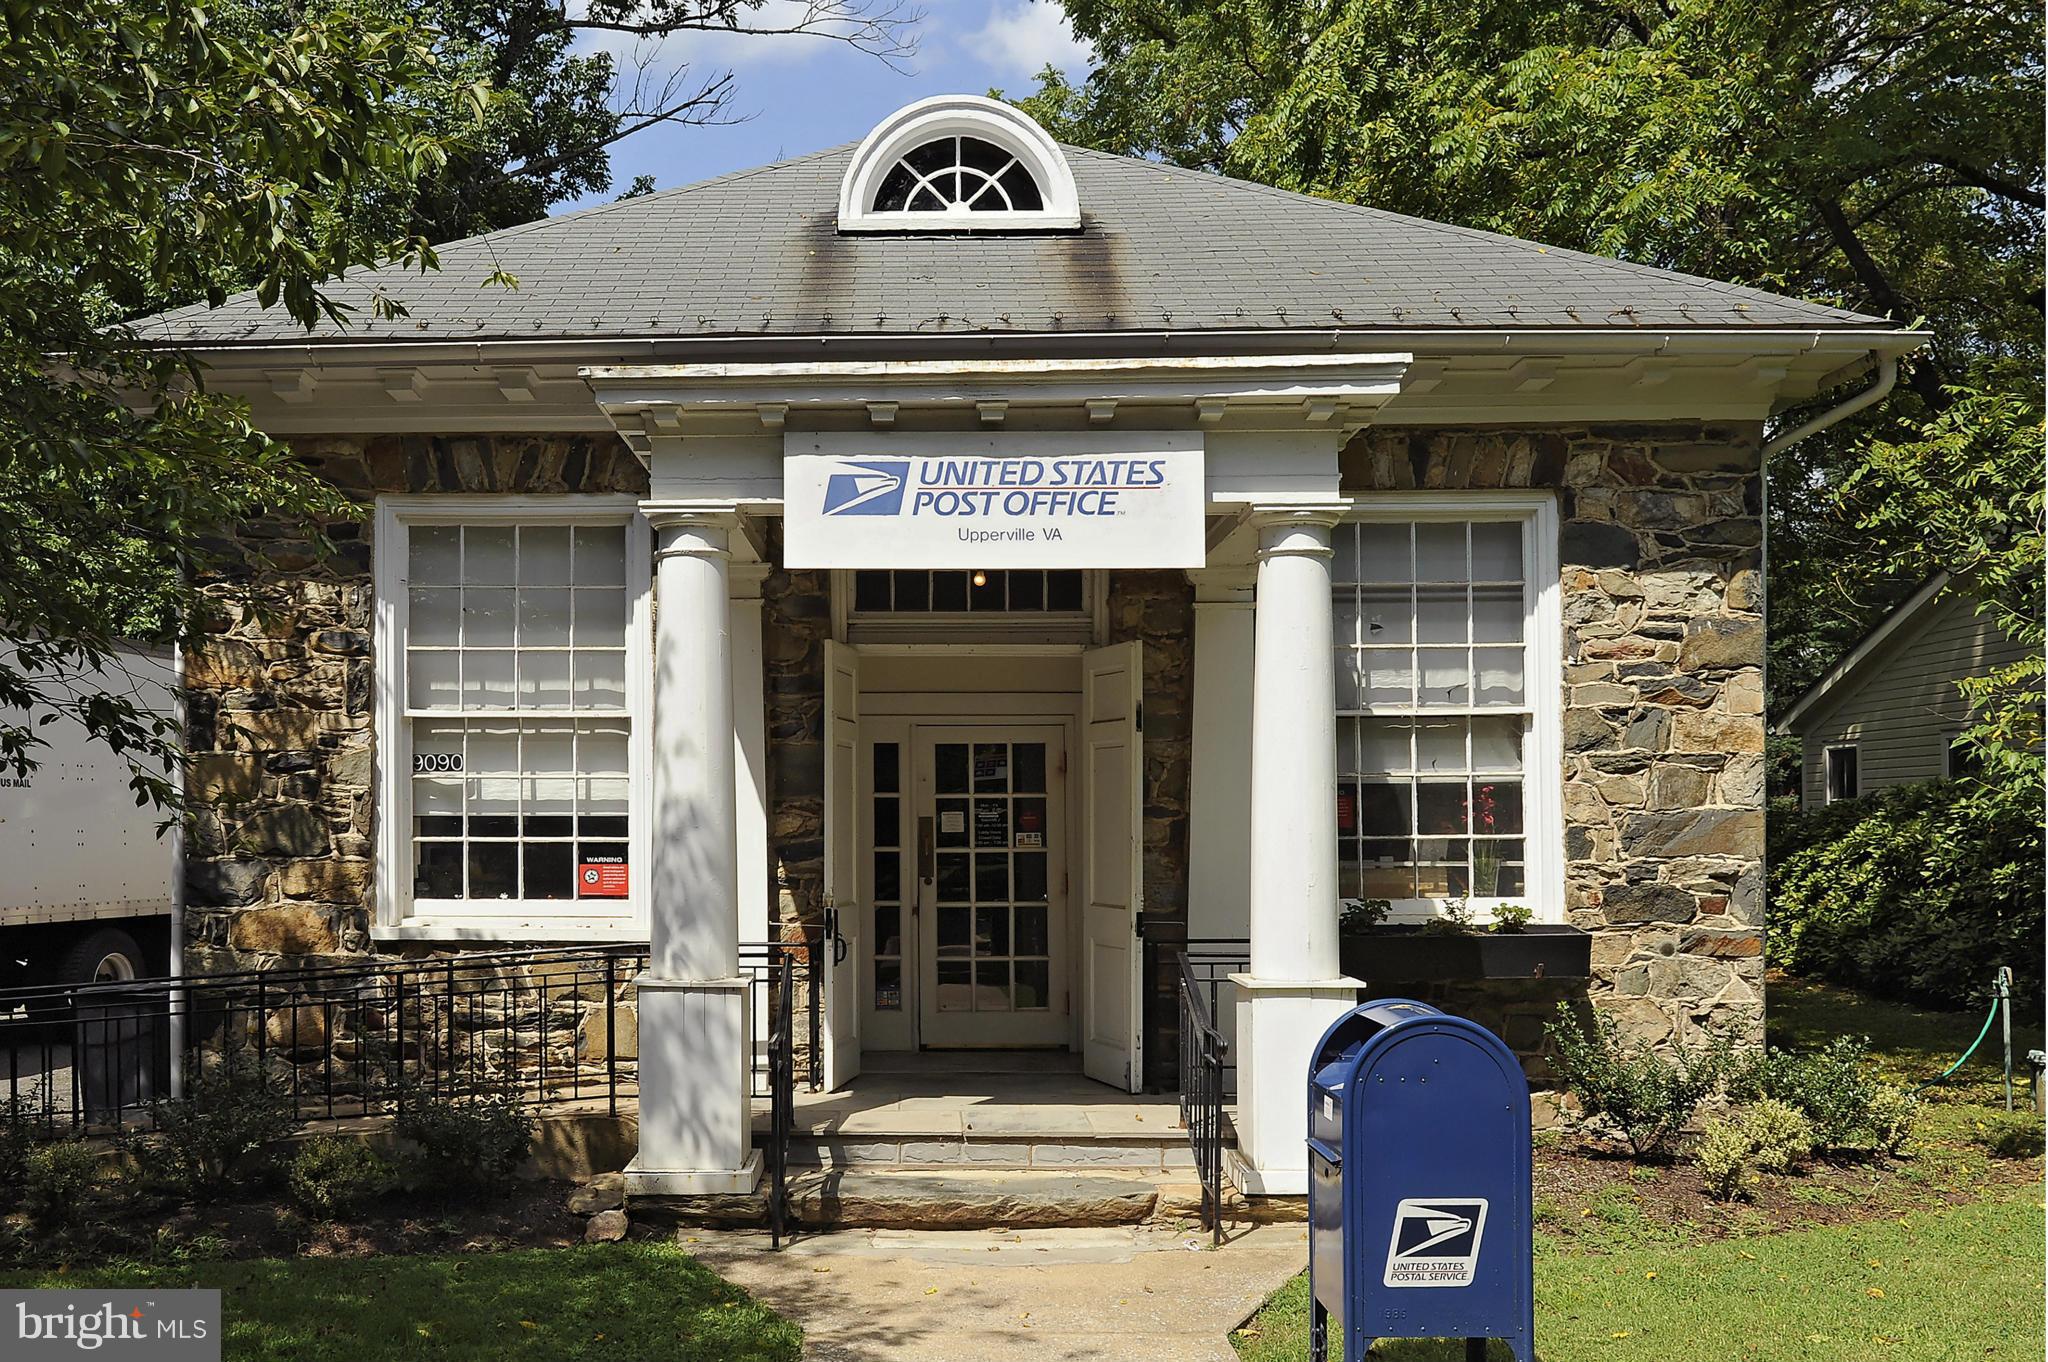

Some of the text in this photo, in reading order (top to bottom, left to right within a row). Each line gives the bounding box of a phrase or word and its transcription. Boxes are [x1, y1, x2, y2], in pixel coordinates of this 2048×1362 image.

[919, 460, 1166, 486] UNITED STATES
[912, 491, 999, 516] POST
[1004, 491, 1119, 516] OFFICE
[958, 528, 1062, 543] Upperville VA
[413, 754, 463, 771] 9090
[0, 778, 31, 788] US MAIL
[1392, 1262, 1464, 1270] UNITED STATES
